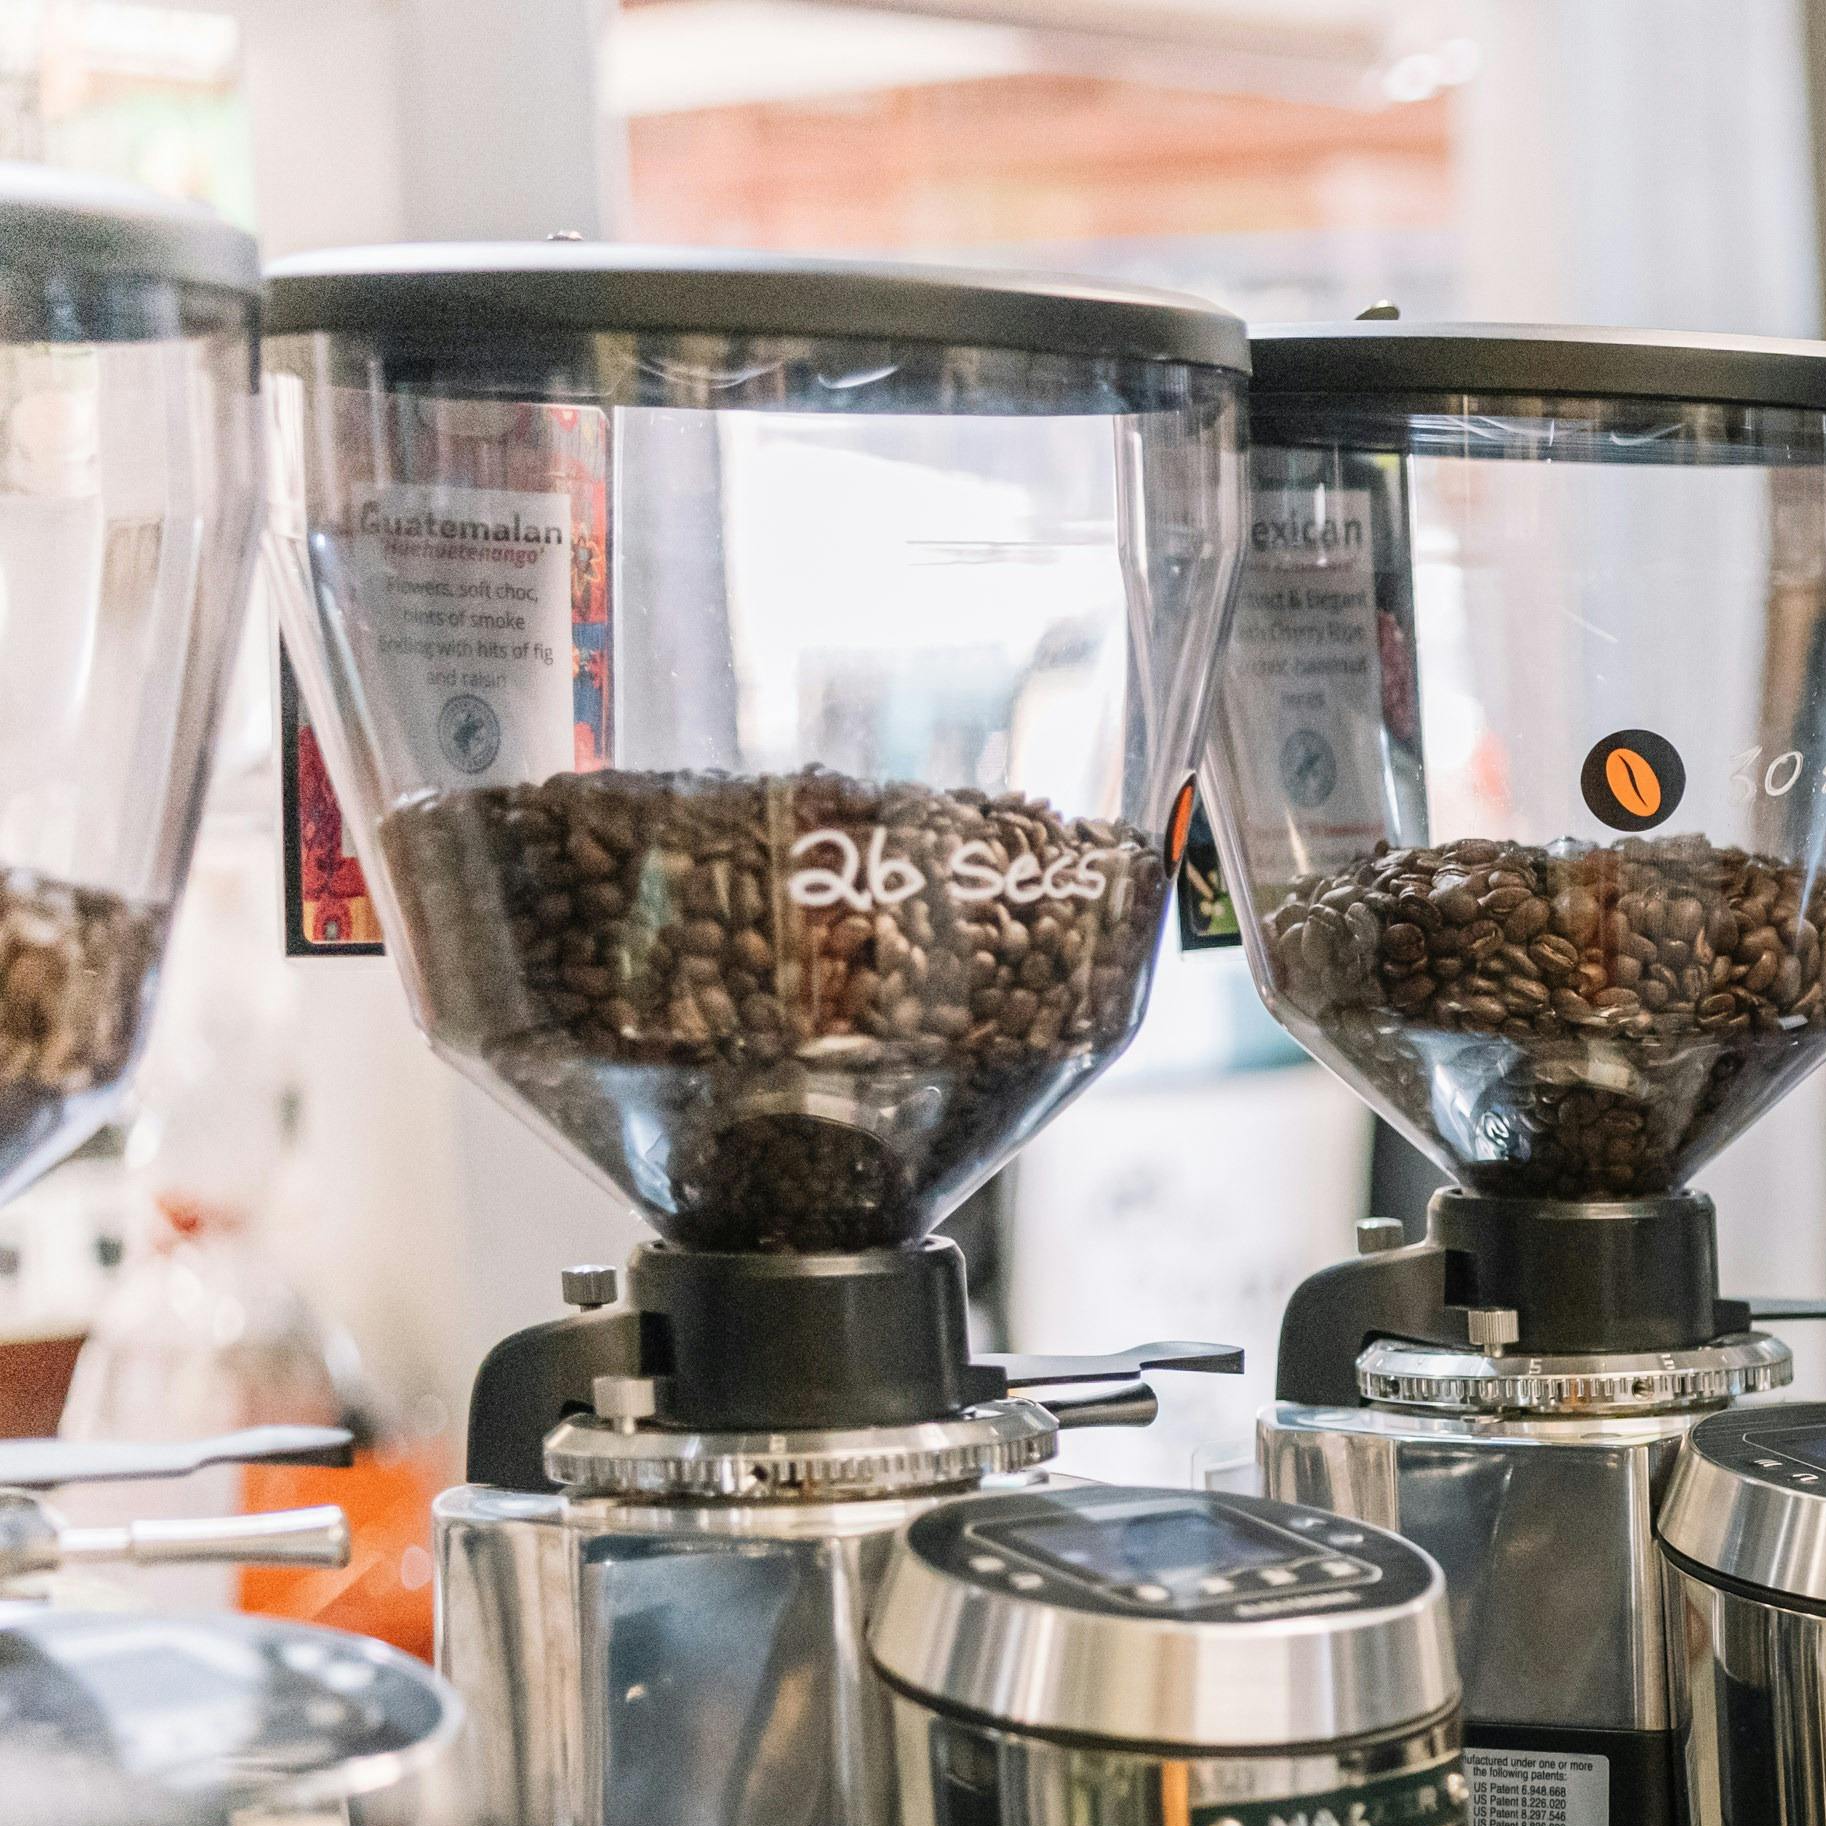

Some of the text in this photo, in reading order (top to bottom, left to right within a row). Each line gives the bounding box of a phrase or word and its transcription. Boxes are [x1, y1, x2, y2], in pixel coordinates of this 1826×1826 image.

[360, 500, 563, 545] Guatemalan
[1251, 507, 1364, 550] exican
[459, 581, 492, 600] soft
[495, 582, 538, 604] choc,
[471, 611, 526, 631] smoke
[478, 641, 508, 659] hits
[512, 641, 530, 659] of
[533, 643, 554, 666] fig
[786, 825, 927, 912] 26
[1463, 1754, 1594, 1772] ufactured under one or more
[1472, 1766, 1568, 1782] the following patents:
[1473, 1782, 1488, 1793] US
[1489, 1783, 1520, 1795] Patent
[1473, 1794, 1488, 1806] US
[1489, 1795, 1520, 1807] Patent
[1473, 1806, 1488, 1818] US
[1489, 1807, 1520, 1820] Patent
